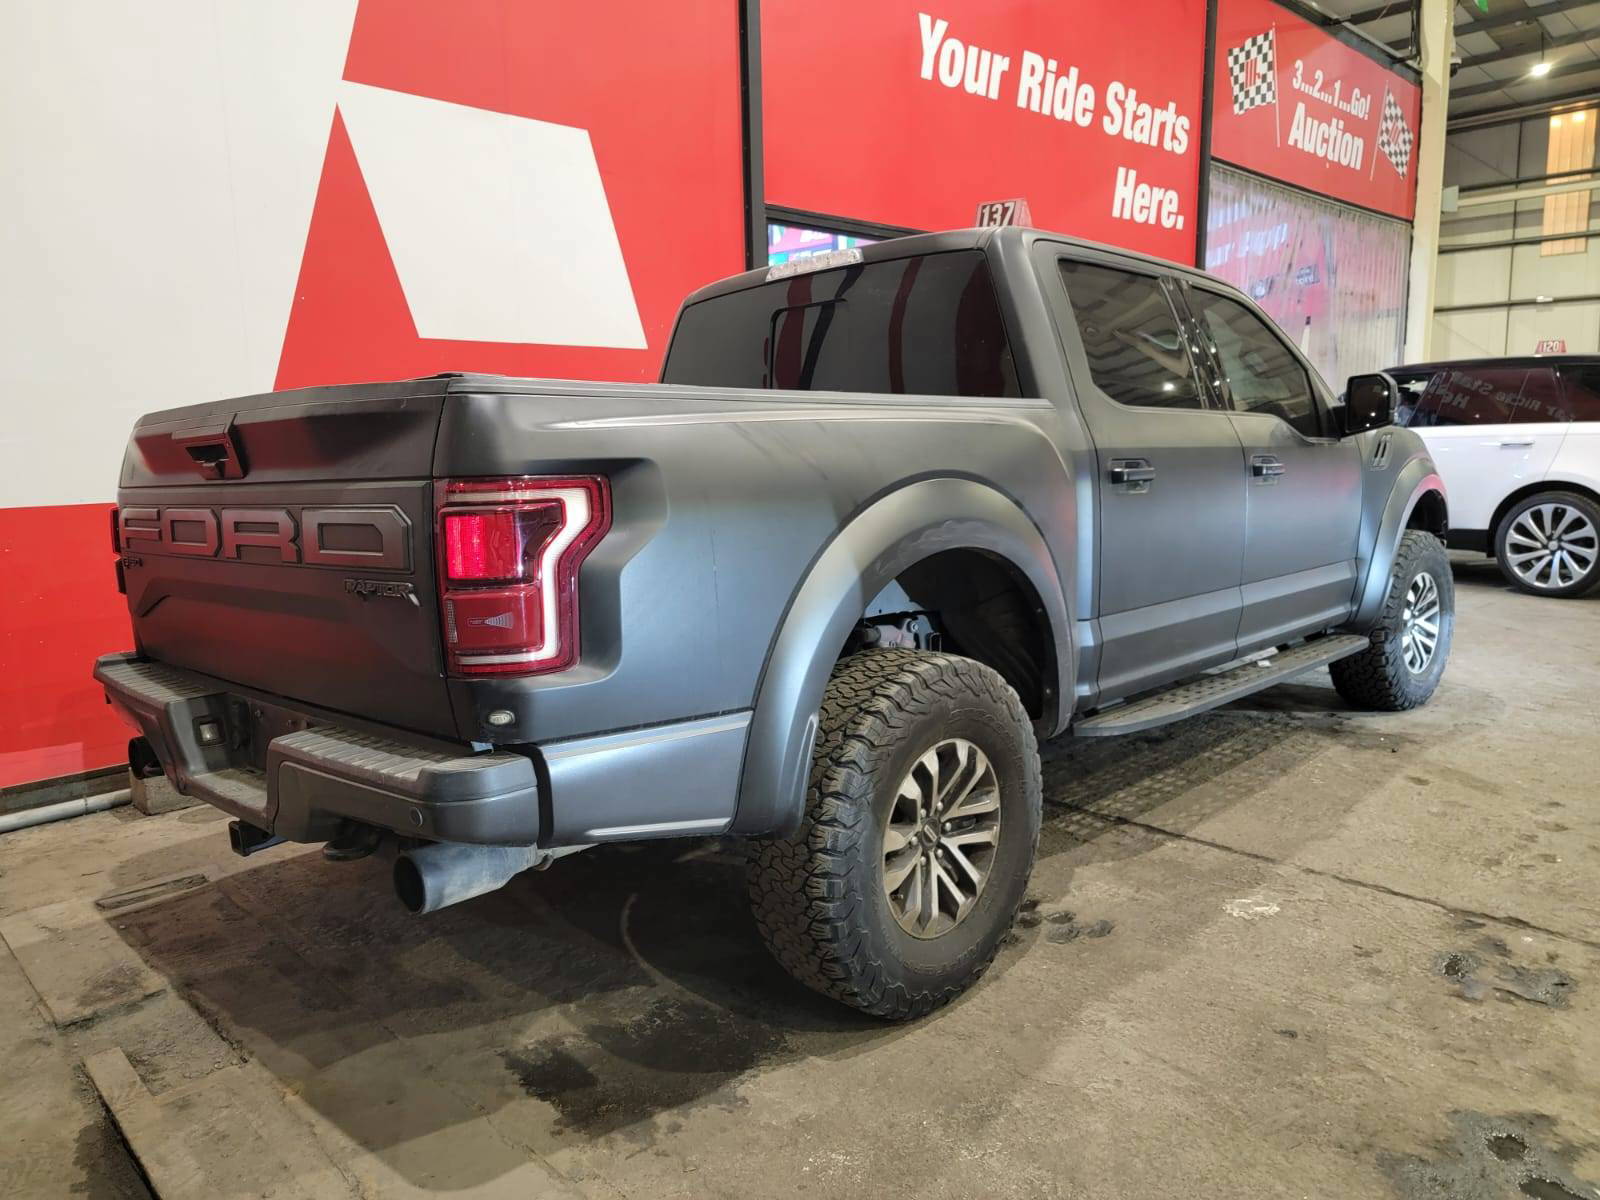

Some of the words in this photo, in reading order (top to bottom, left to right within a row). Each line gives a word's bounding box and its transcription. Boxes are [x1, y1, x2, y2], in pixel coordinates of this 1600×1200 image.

[918, 11, 1010, 100] Your
[1017, 49, 1096, 127] Ride
[1102, 80, 1190, 154] Starts
[1287, 101, 1364, 170] Auction
[980, 201, 1016, 228] 137
[1111, 165, 1185, 231] Here.
[1542, 340, 1561, 353] 120
[119, 507, 412, 571] FORD
[343, 578, 421, 607] RAPTOR
